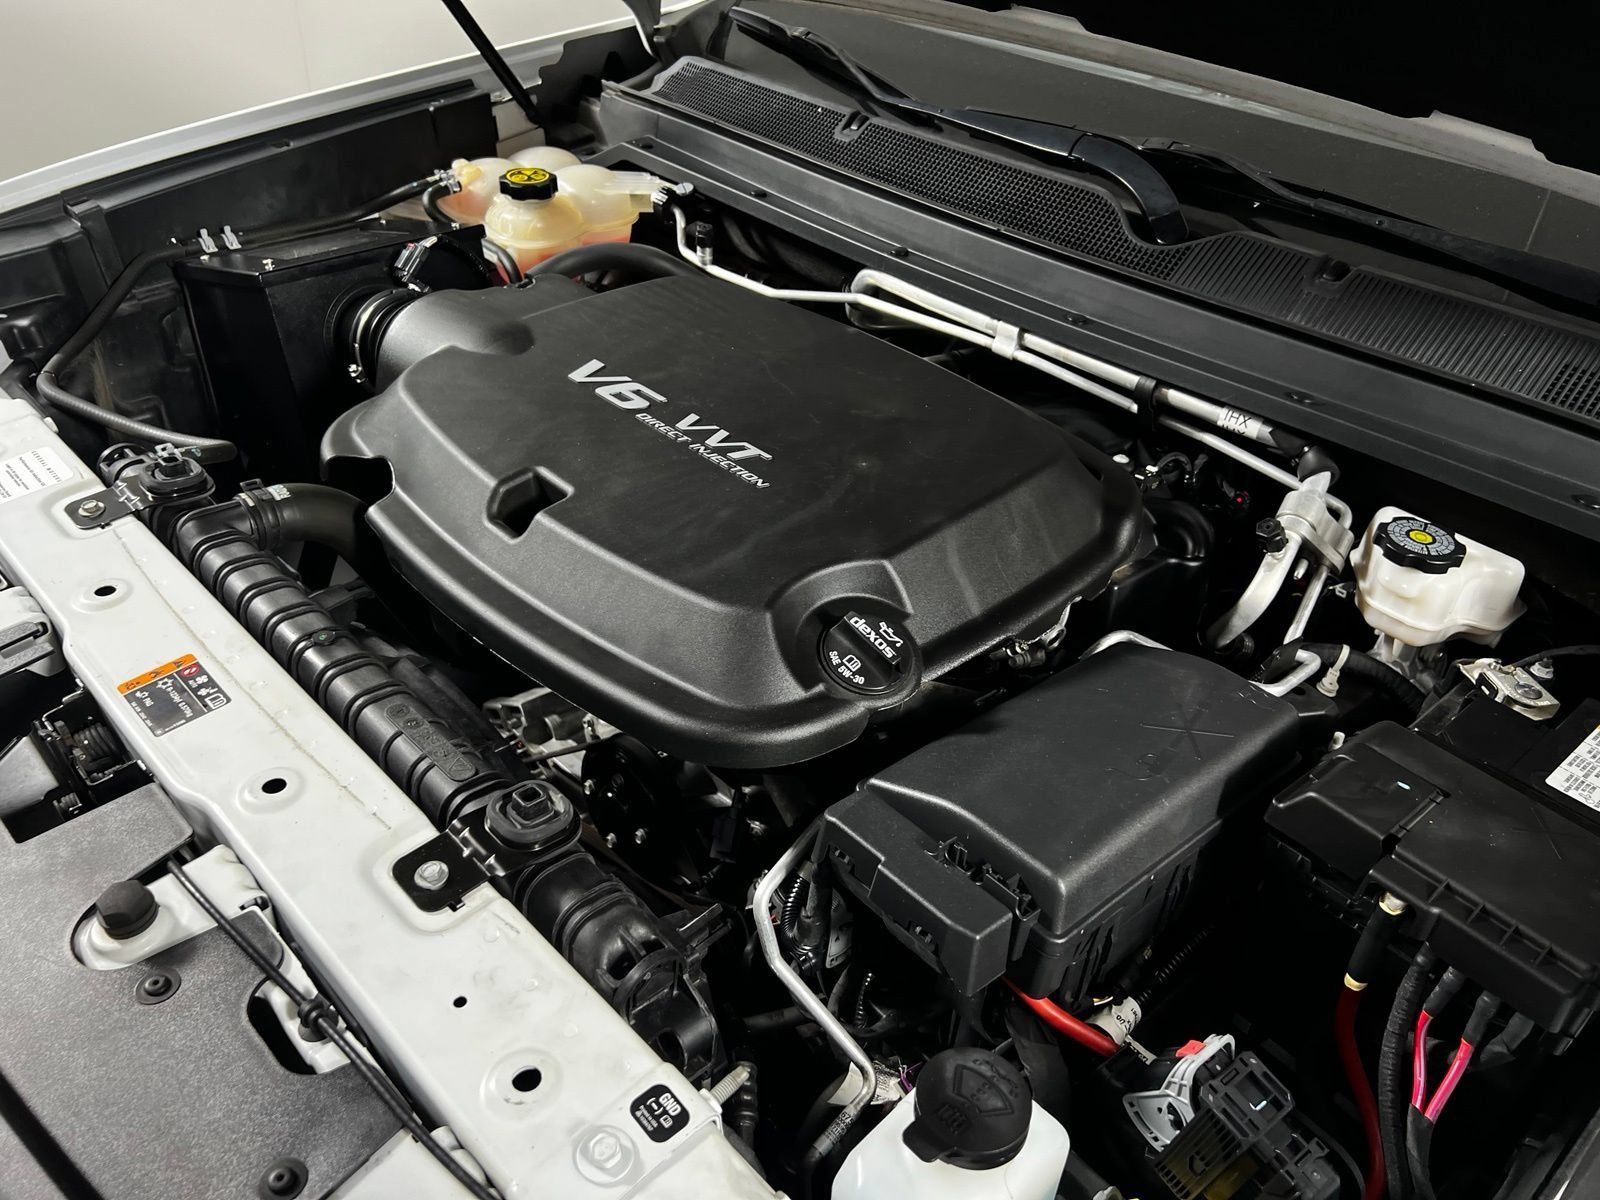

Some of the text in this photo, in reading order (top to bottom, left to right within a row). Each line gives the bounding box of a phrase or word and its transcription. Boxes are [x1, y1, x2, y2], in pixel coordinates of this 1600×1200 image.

[567, 358, 773, 461] V6 VVT
[634, 412, 771, 489] DIRECT INJECTION
[849, 616, 897, 658] dexos
[829, 650, 865, 685] SAE 5W-30
[658, 1092, 682, 1116] GND
